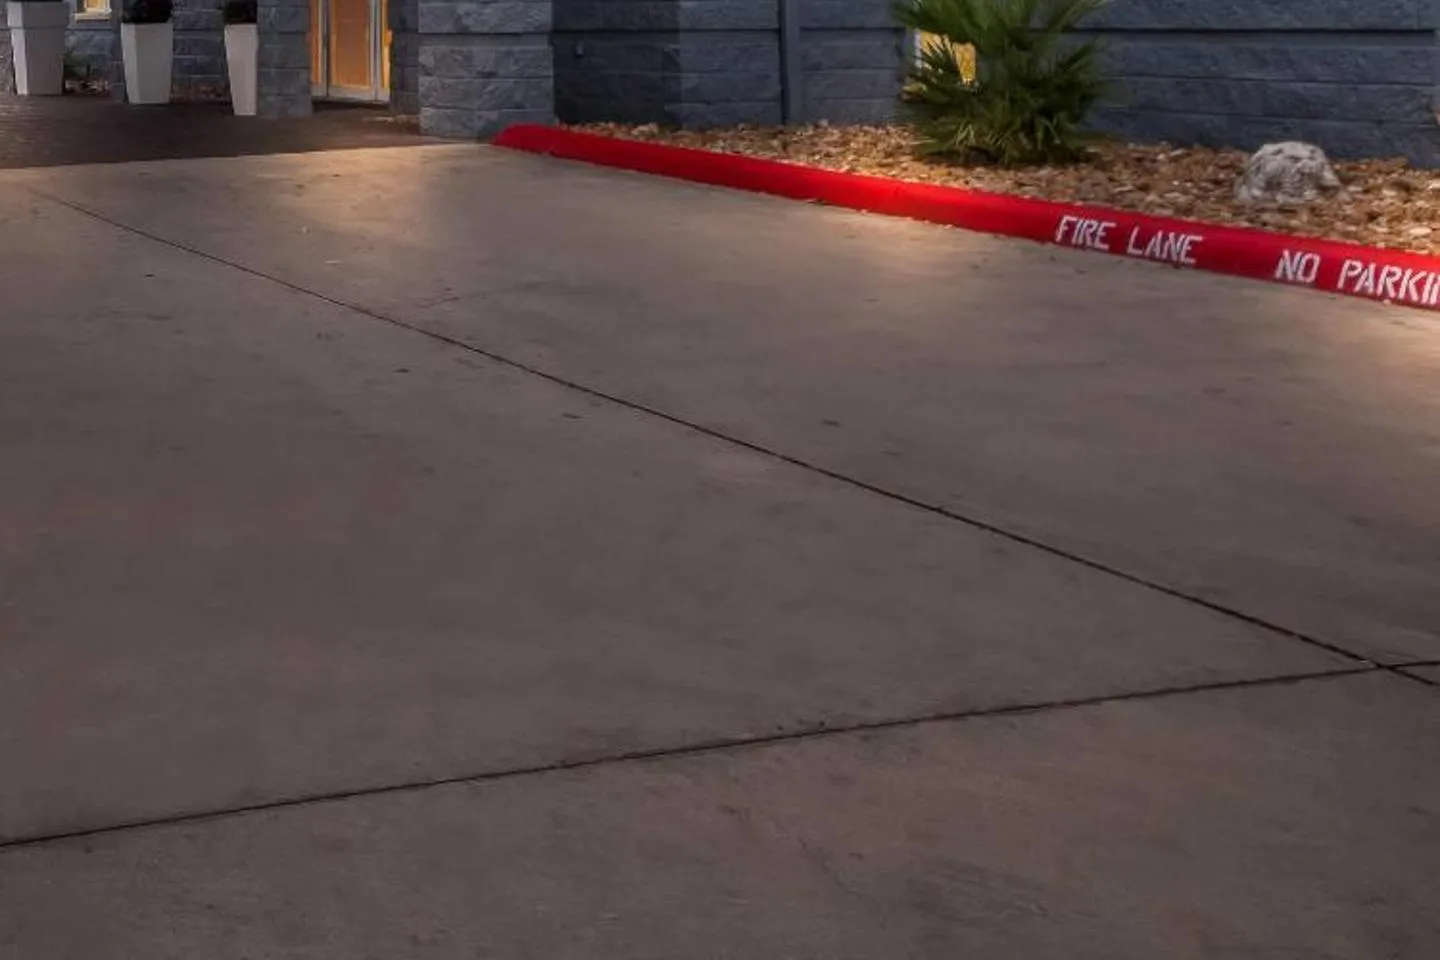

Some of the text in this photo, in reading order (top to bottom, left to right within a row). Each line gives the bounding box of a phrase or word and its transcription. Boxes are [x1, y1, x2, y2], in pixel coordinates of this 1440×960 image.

[1054, 214, 1116, 251] FIRE
[1126, 225, 1203, 265] LANE
[1274, 249, 1321, 284] NO
